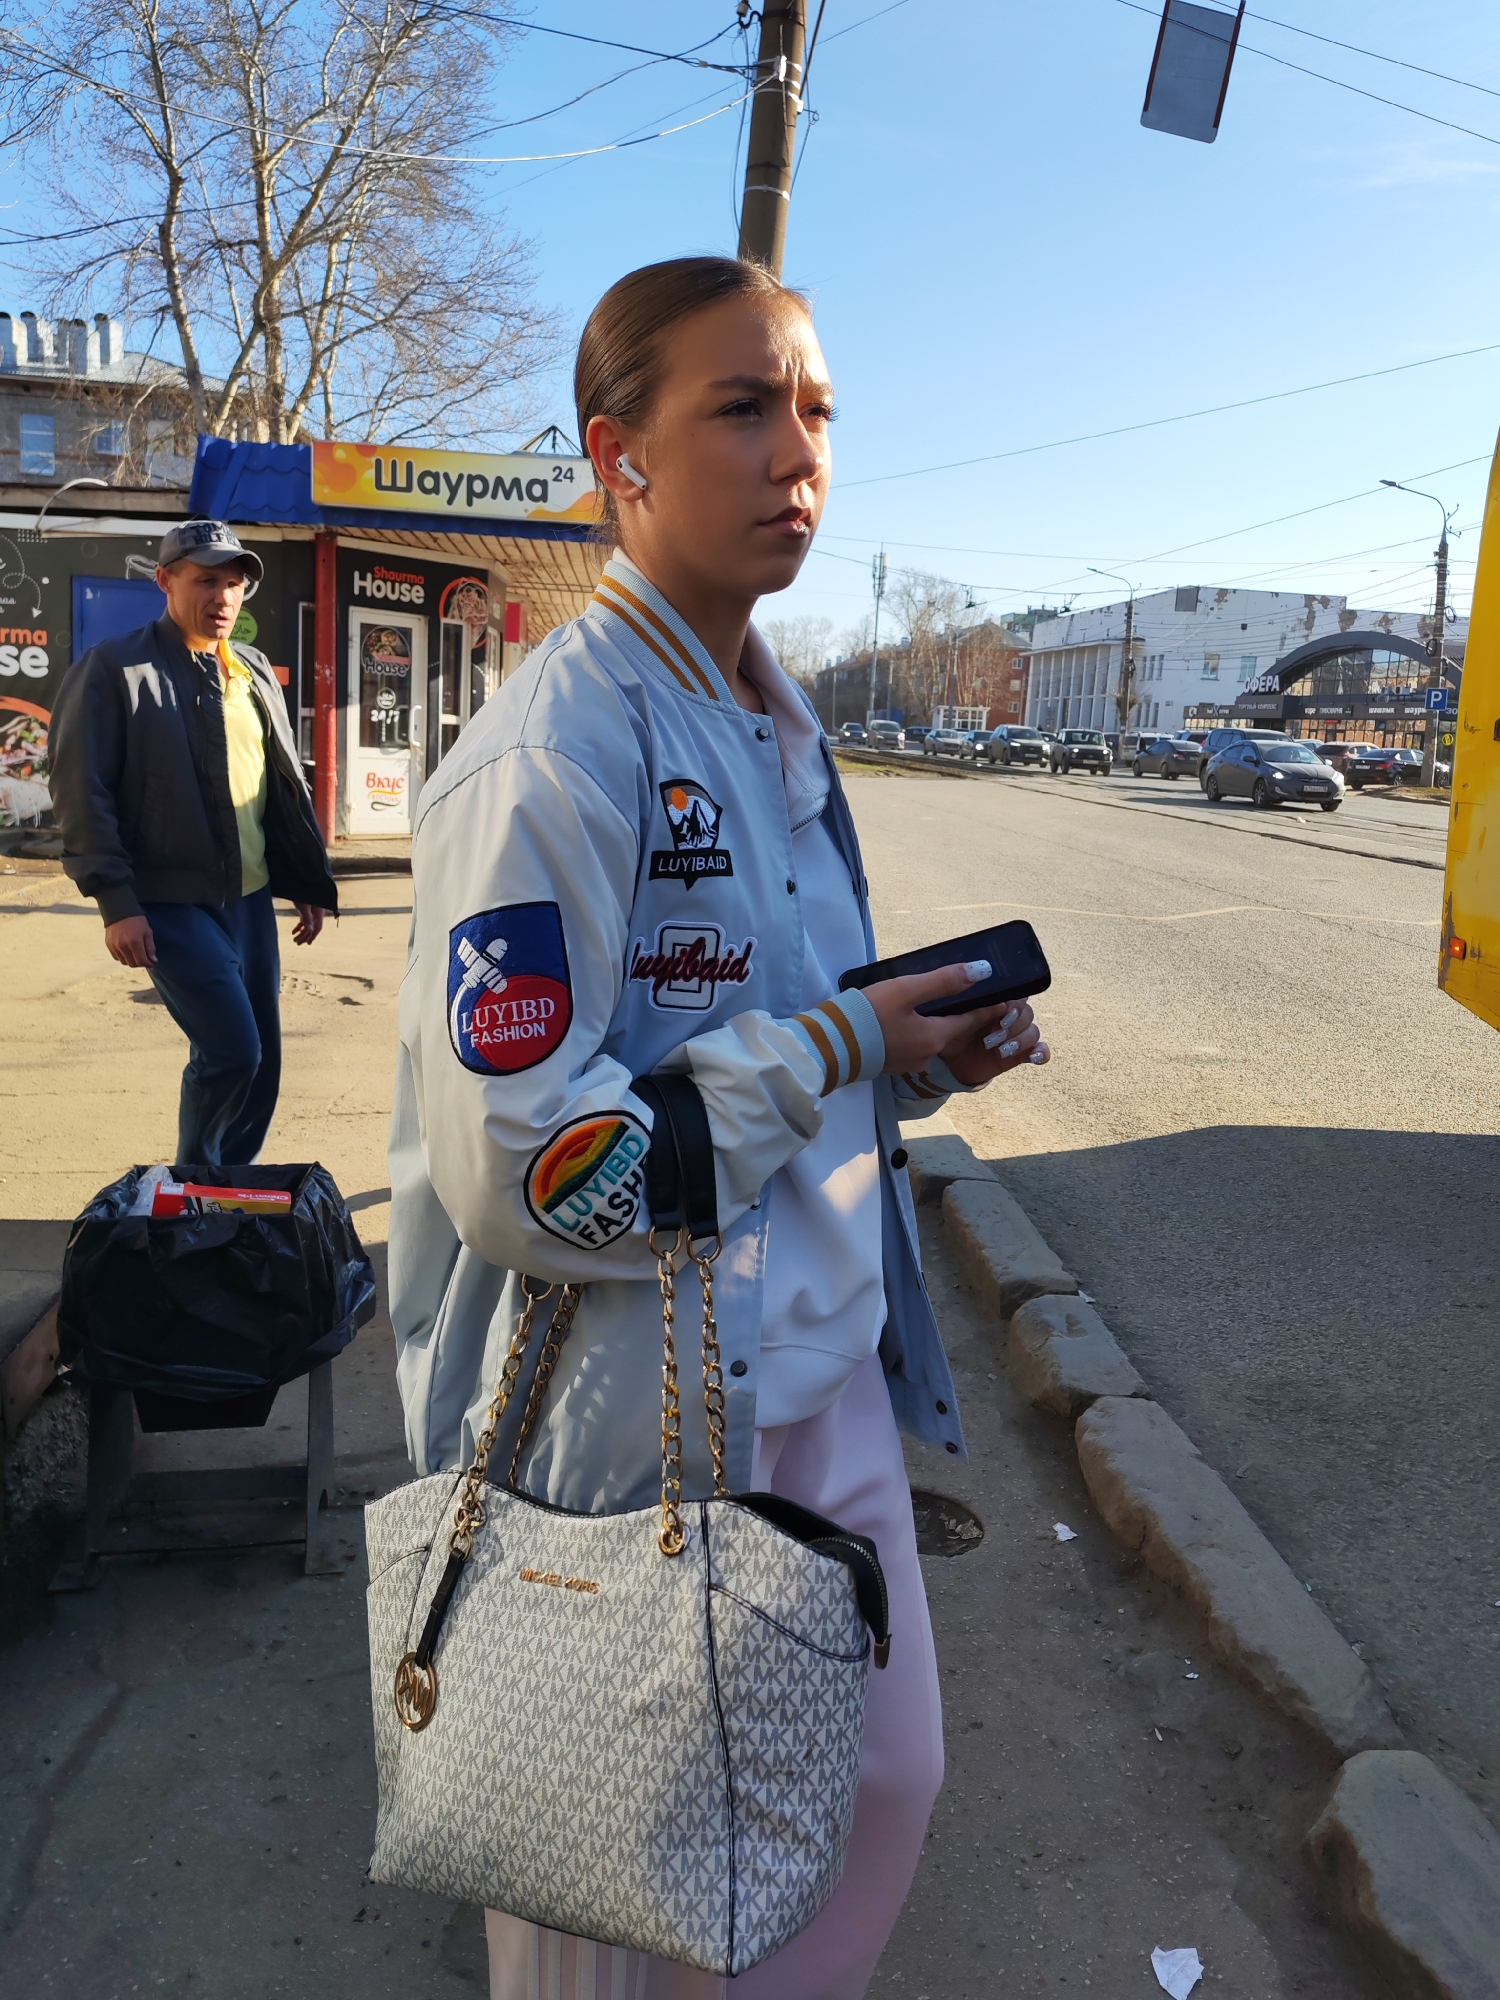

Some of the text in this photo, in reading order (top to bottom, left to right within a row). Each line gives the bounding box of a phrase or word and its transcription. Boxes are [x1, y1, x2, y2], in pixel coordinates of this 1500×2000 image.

[375, 458, 575, 507] Шаурма 24
[374, 566, 424, 584] Shaurma
[354, 570, 425, 604] House
[364, 658, 408, 678] House
[1245, 675, 1280, 693] СФЕРА
[371, 709, 400, 724] 24/7
[366, 772, 405, 792] Вкус
[658, 856, 727, 872] LUYIBAID
[461, 998, 555, 1034] LUYIBD
[470, 1021, 546, 1048] FASHION
[551, 1134, 645, 1232] LUYIBD
[732, 1515, 756, 1535] MK
[713, 1535, 800, 1561] MK MK MK
[724, 1556, 844, 1585] MK MK MK MK
[735, 1578, 826, 1604] MK MK MK
[571, 1602, 649, 1631] MK MK MK
[776, 1605, 838, 1626] MK MK
[506, 1612, 684, 1658] MK MK MK MK MK MK MK
[730, 1619, 758, 1641] MK
[821, 1626, 850, 1646] MK
[536, 1638, 693, 1681] MK MK MK MK MK MK
[746, 1643, 804, 1666] MK MK
[567, 1664, 646, 1695] MK MK MK
[721, 1661, 850, 1687] MK MK MK MK
[677, 1682, 705, 1704] MK
[733, 1684, 858, 1708] MK MK MK MK
[558, 1704, 698, 1747] MK MK MK MK MK
[746, 1707, 842, 1727] MK MK MK
[566, 1727, 592, 1749] MK
[726, 1725, 850, 1747] MK MK MK MK
[740, 1748, 804, 1768] MK MK
[752, 1767, 783, 1786] MK
[819, 1768, 844, 1786] MK
[766, 1787, 828, 1807] MK MK
[745, 1807, 838, 1827] MK MK MK
[758, 1824, 822, 1847] MK MK
[738, 1844, 831, 1866] MK MK MK
[752, 1867, 813, 1889] MK MK
